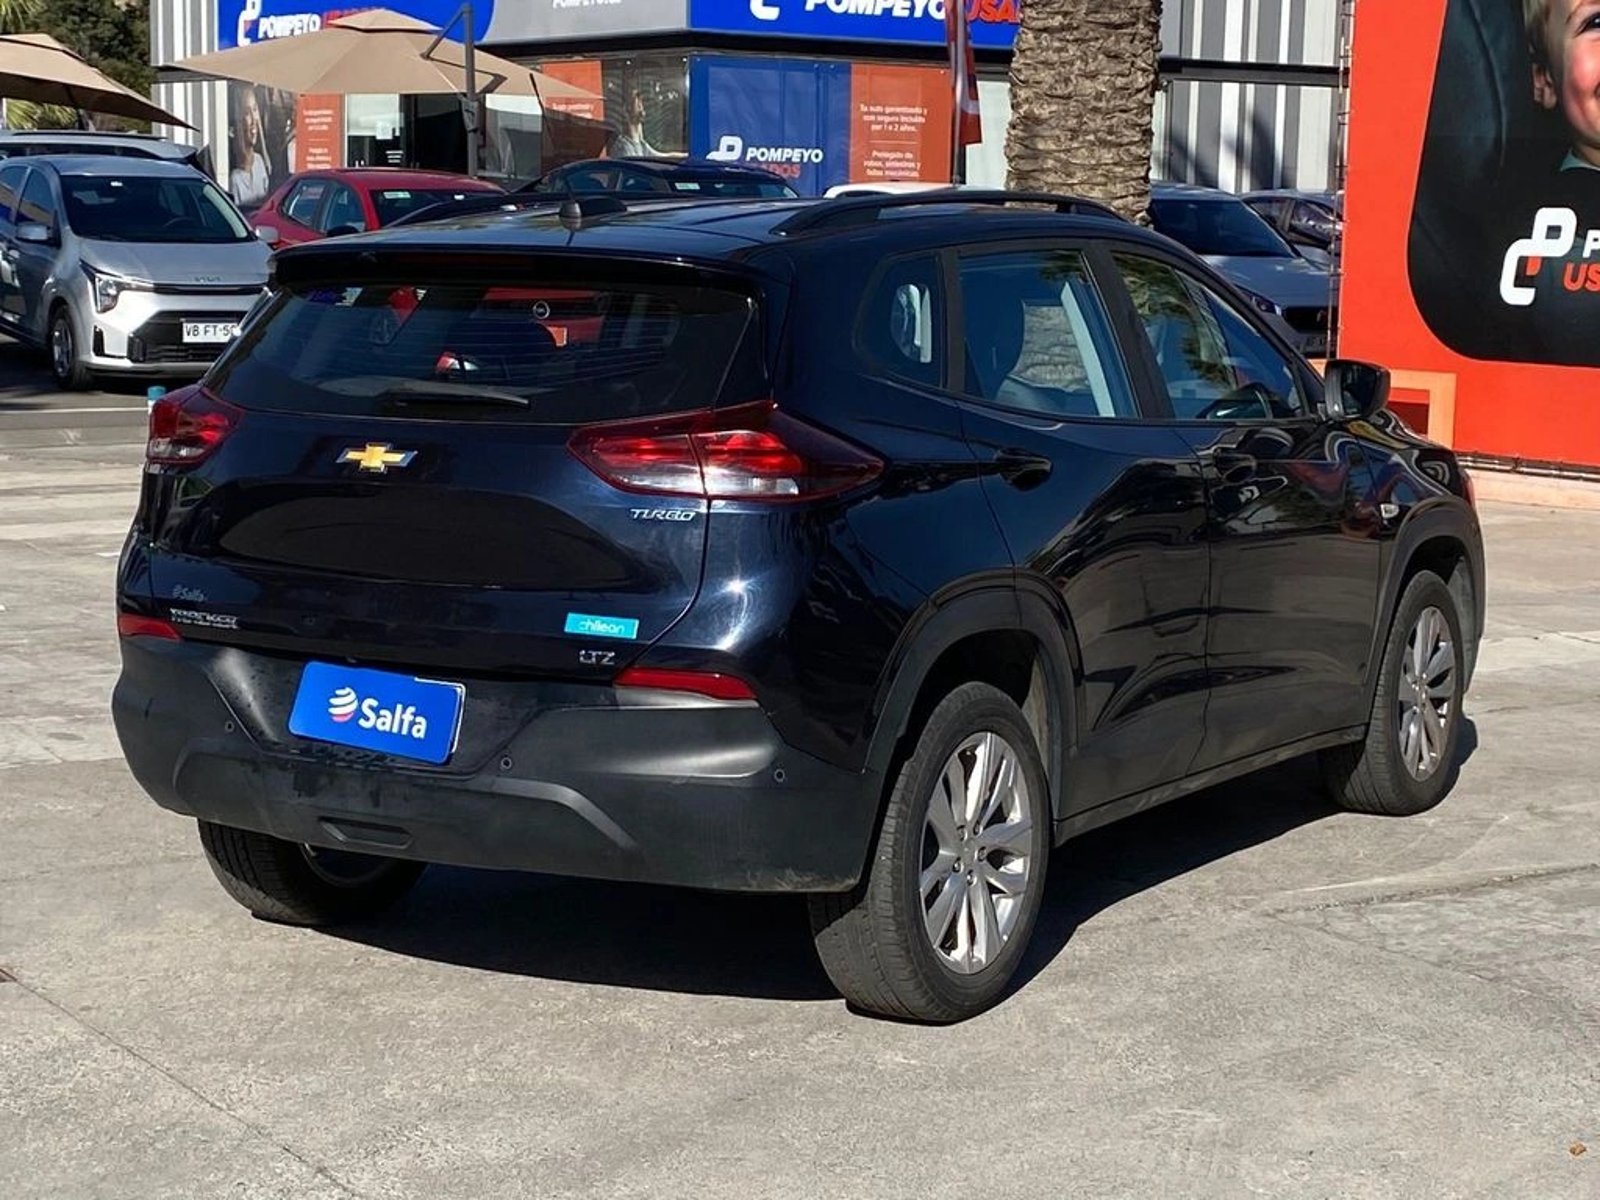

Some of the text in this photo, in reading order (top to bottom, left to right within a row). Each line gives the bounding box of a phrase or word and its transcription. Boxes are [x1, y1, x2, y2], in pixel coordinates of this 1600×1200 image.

[258, 13, 321, 39] POMPEYO
[745, 147, 824, 163] POMPEYO
[185, 324, 200, 337] VB
[630, 508, 697, 521] TURBO
[579, 649, 616, 665] LTZ
